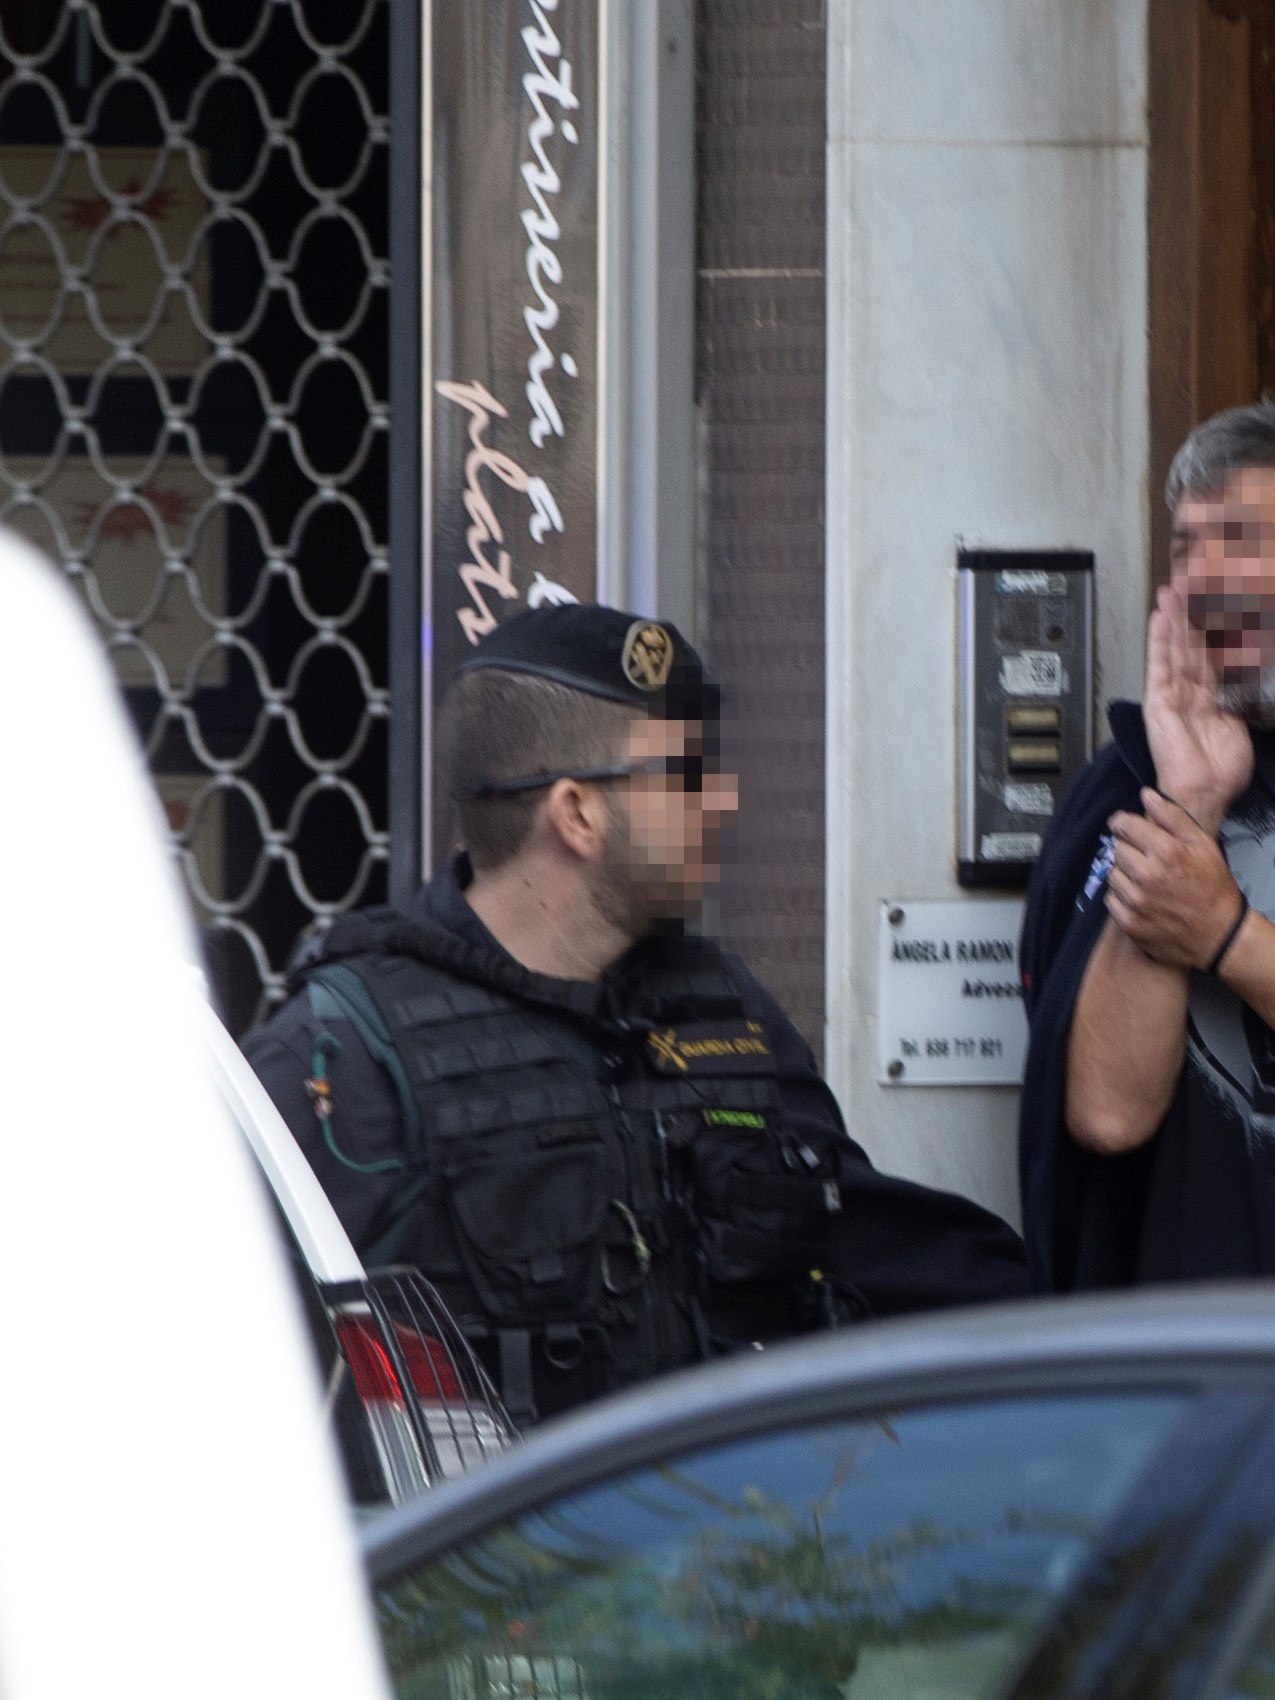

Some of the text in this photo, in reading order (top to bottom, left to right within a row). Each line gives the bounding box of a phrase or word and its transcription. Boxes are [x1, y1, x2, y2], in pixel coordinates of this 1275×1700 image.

[520, 0, 580, 449] stisseria
[435, 379, 528, 647] plats
[528, 475, 565, 545] a
